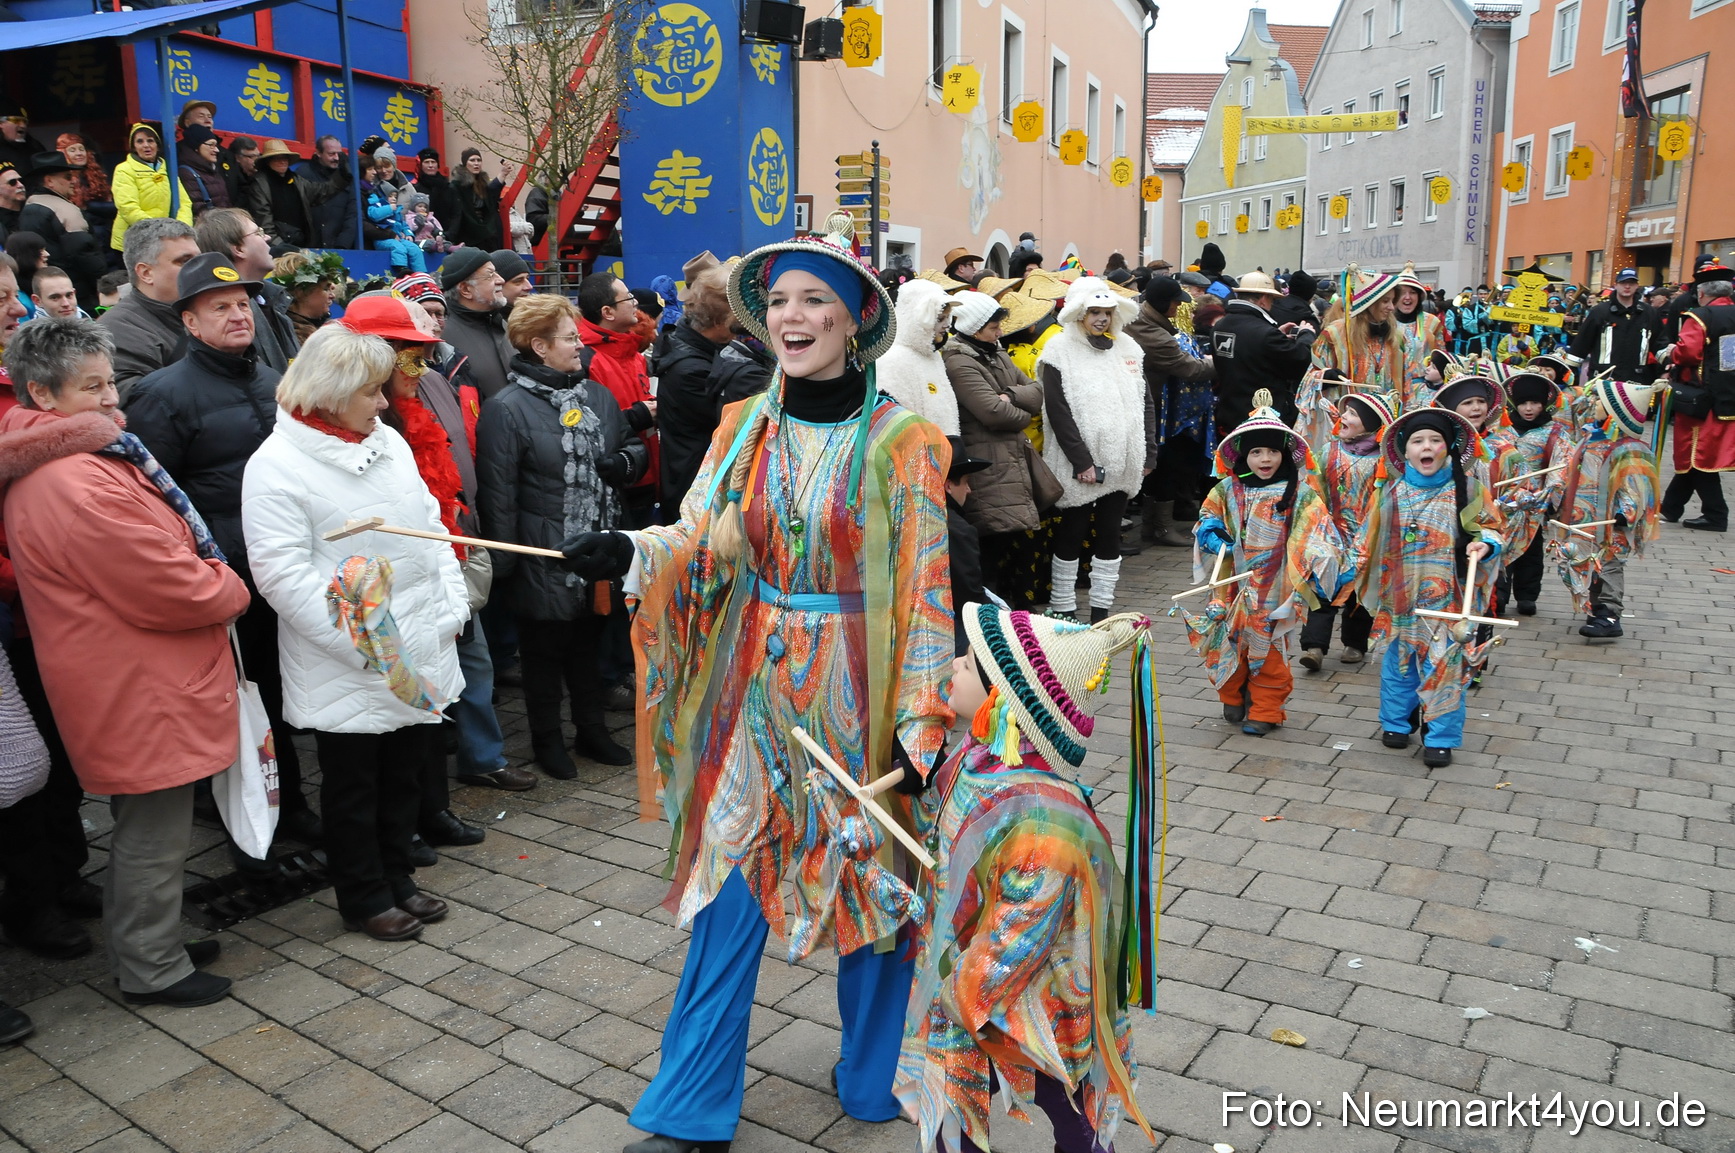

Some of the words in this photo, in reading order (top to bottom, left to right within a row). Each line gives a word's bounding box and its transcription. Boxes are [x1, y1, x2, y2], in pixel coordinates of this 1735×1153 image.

[1473, 81, 1485, 144] UHREN
[1466, 154, 1480, 242] SCHMUCK
[1624, 216, 1676, 238] GÖTZ
[1337, 239, 1368, 261] OPTIK
[1370, 234, 1401, 259] OEXL
[1503, 310, 1521, 319] Kaiser
[1528, 313, 1550, 323] Gefolge
[1519, 324, 1529, 332] 32
